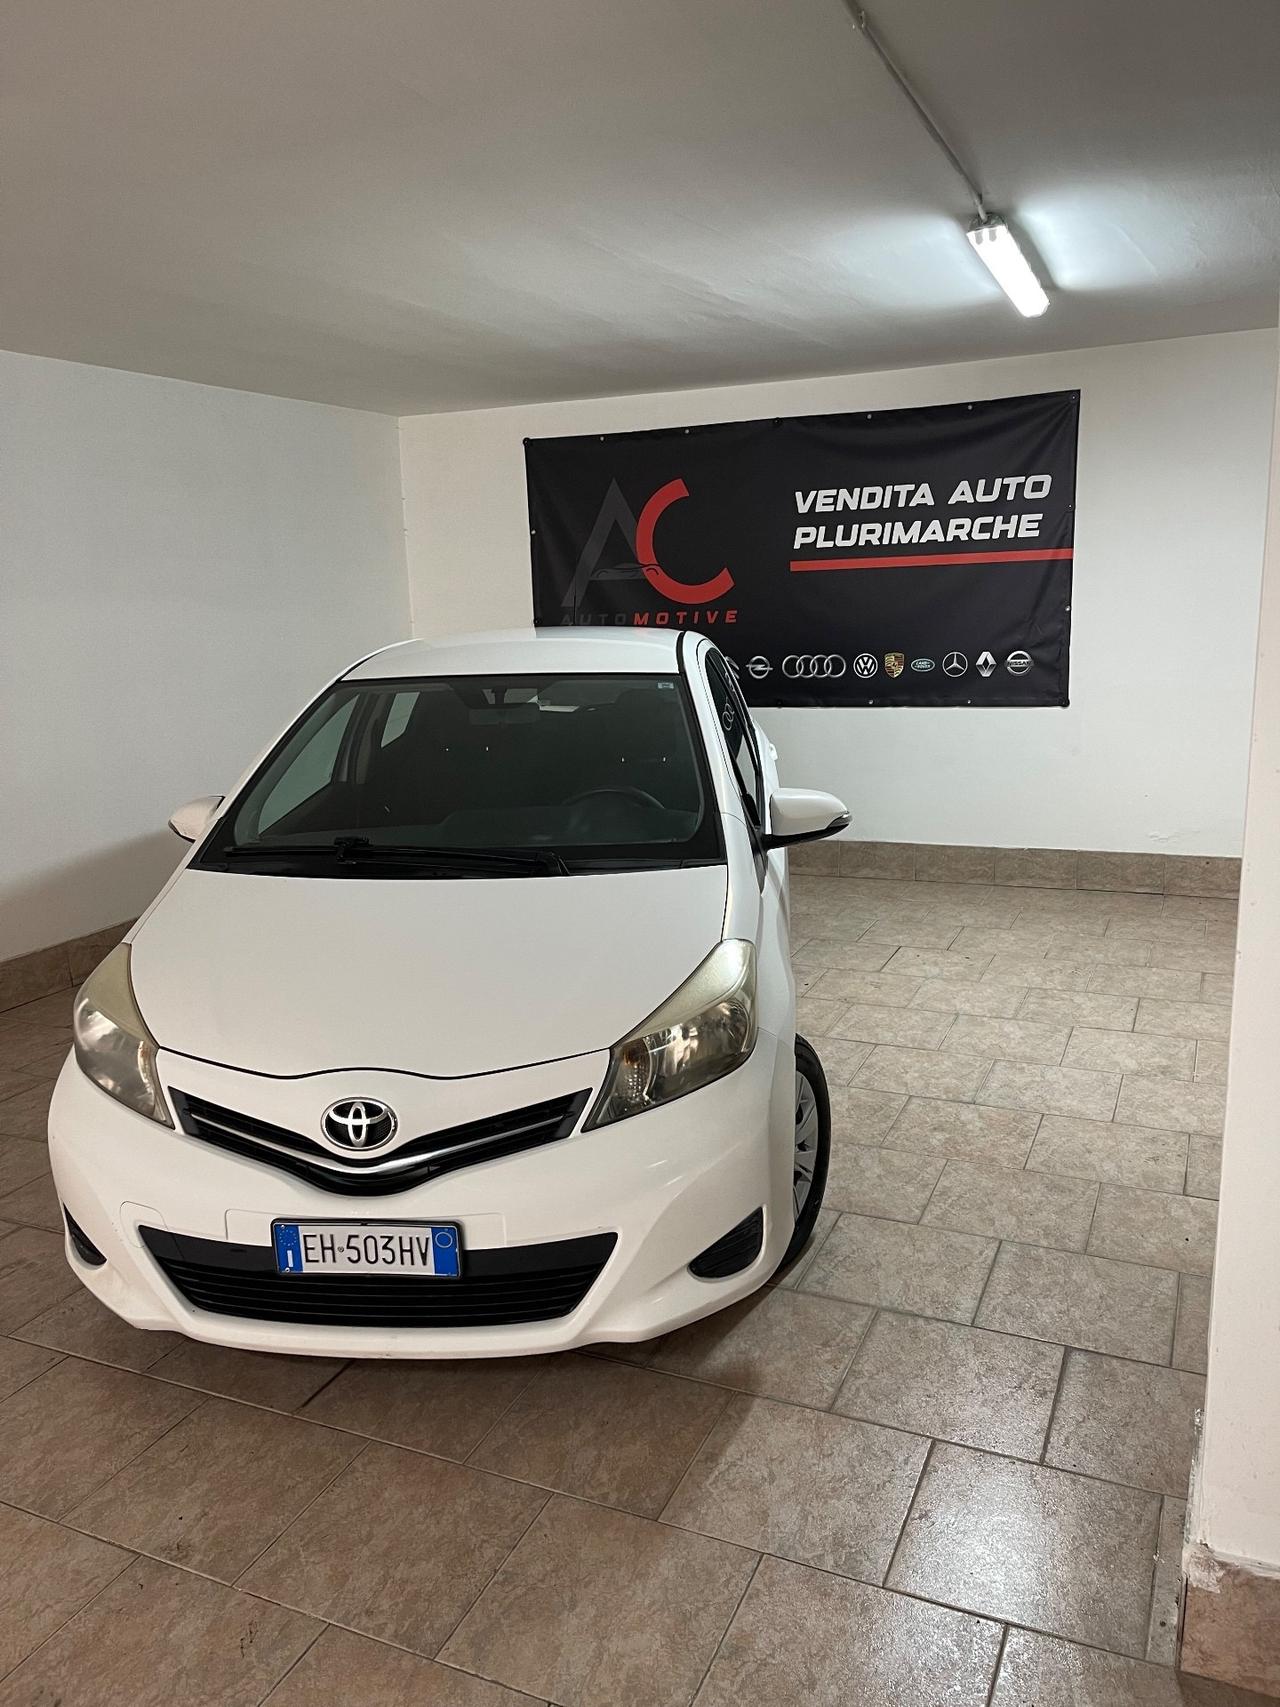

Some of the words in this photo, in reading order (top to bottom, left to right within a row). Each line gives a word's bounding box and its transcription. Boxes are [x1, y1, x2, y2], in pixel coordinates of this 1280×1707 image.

[795, 482, 935, 514] VENDITA
[948, 474, 1052, 505] AUTO
[793, 513, 1044, 550] PLURIMARCHE
[561, 610, 738, 626] AUTOMOTIVE
